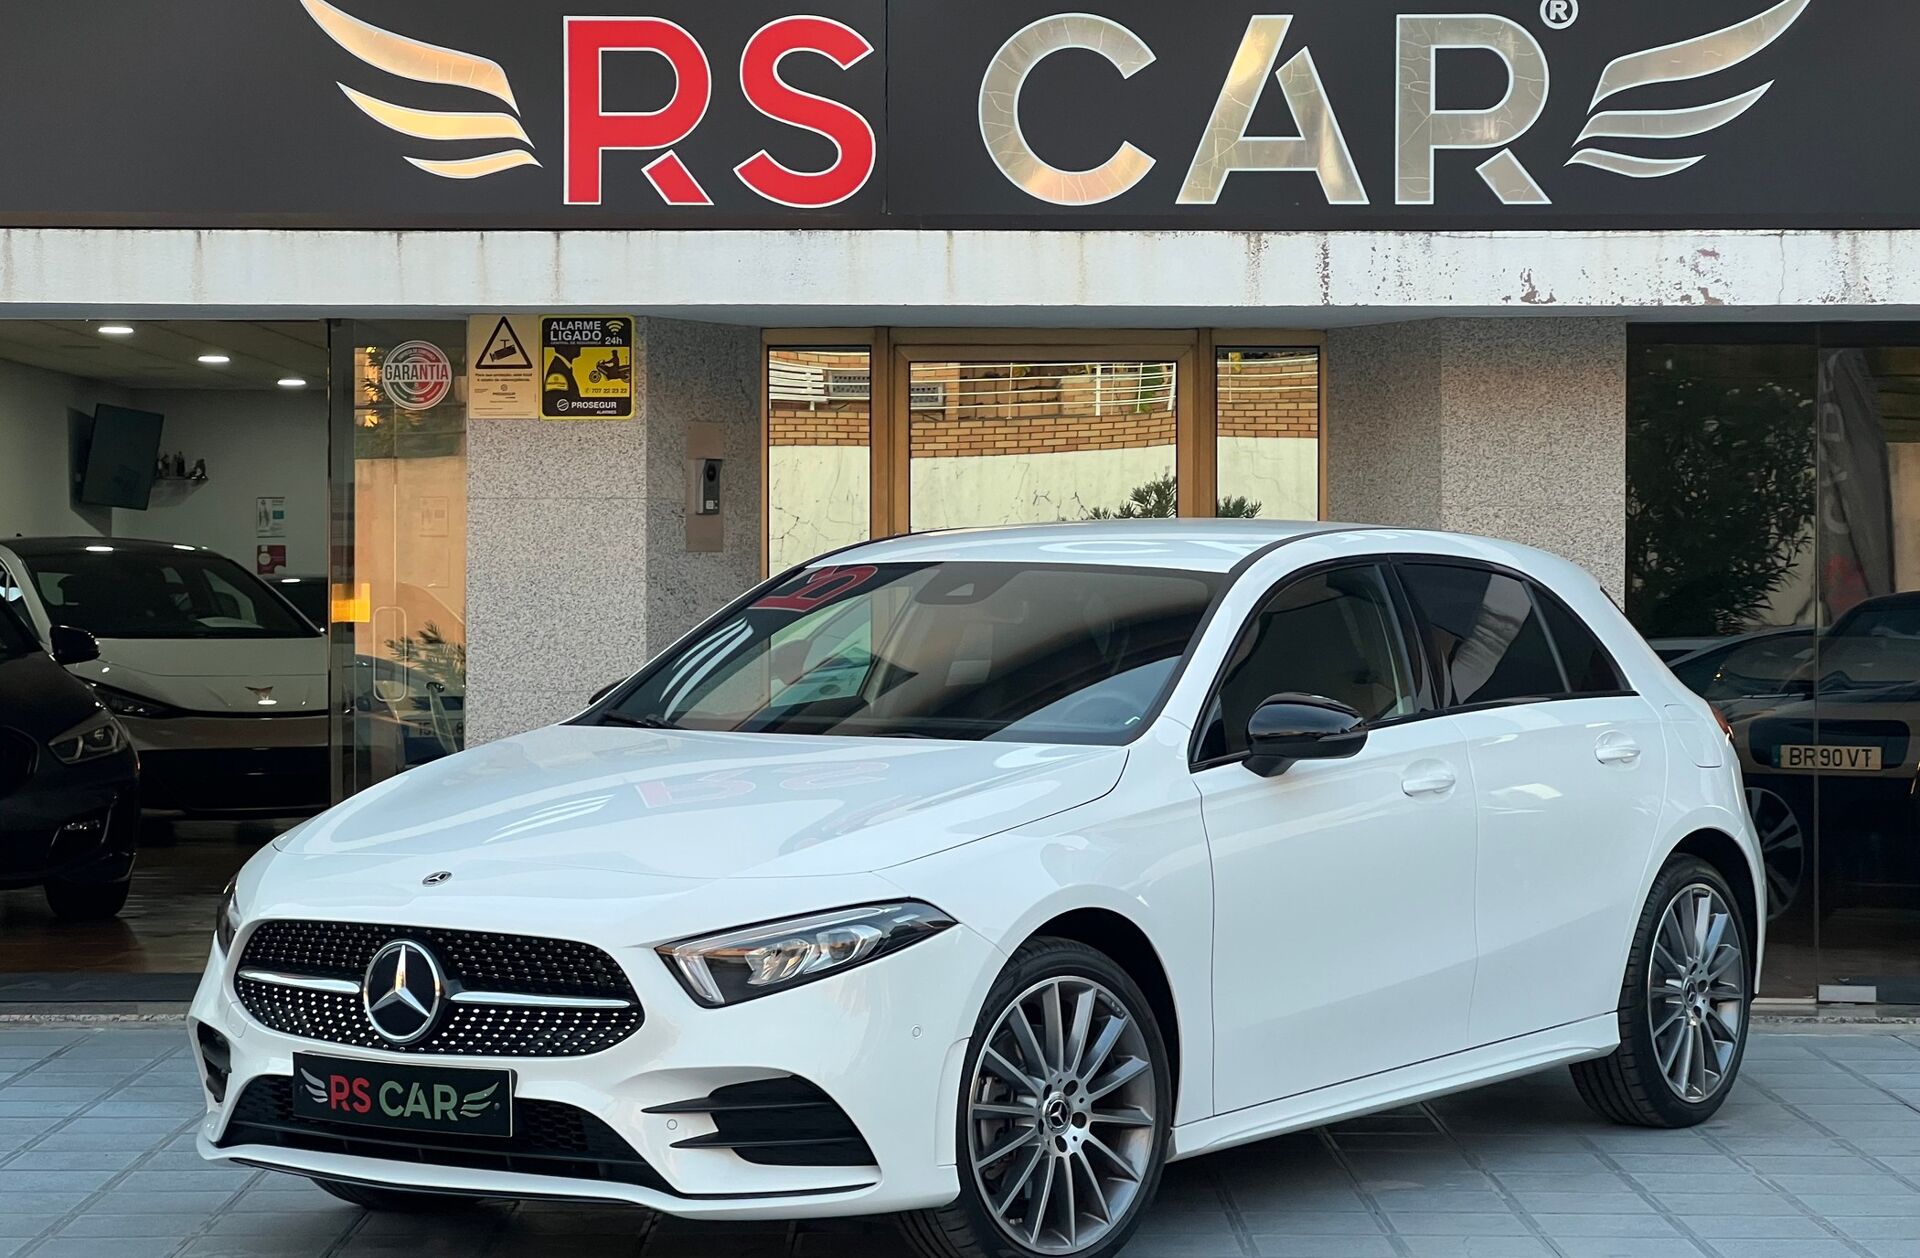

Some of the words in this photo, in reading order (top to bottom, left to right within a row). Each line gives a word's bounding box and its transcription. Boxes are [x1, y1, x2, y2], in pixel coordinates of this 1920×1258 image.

[563, 14, 874, 208] RS
[978, 13, 1552, 205] CAR
[551, 321, 601, 331] ALARME
[550, 331, 602, 341] LIGADO
[605, 336, 623, 345] 24h
[384, 364, 449, 381] GARANTIA
[571, 401, 617, 409] PROSEGUR
[330, 1074, 372, 1113] RS
[379, 1080, 459, 1121] CAR
